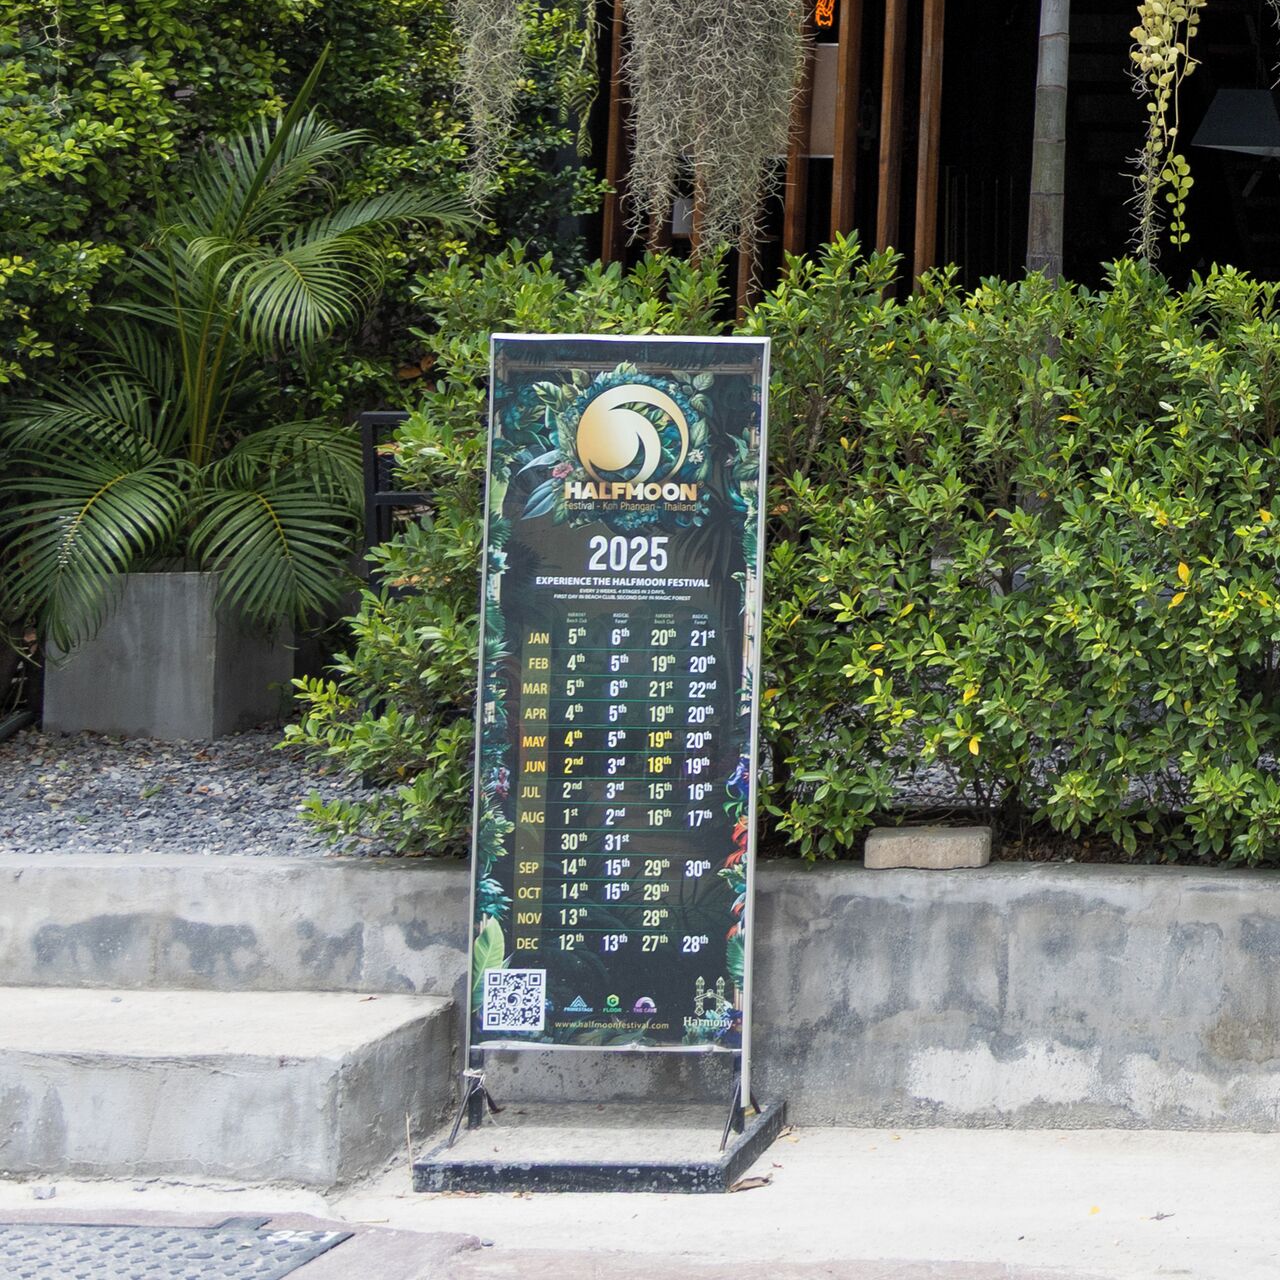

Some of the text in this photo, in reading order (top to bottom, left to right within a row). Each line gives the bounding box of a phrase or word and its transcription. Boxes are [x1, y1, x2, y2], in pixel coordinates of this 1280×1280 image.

[564, 482, 697, 501] HALFMOON
[564, 502, 594, 510] Festival
[620, 503, 655, 512] Phangan
[664, 503, 696, 511] Thailand
[588, 535, 669, 572] 2025
[536, 577, 710, 587] EXPERIENCE THE HALFMOON FESTIVAL
[528, 629, 715, 646] JAN 5th 6th 20th 21st
[529, 654, 715, 672] FEB 4th 5th 19th 20th
[523, 679, 716, 698] MAR 5th 6th 21st 22nd
[524, 704, 713, 723] APR 4th 5th 19th 20th
[523, 731, 712, 748] MAY 4th 5th 19th 20th
[524, 757, 709, 774] JUN 2nd 3rd 18th 19th
[522, 782, 712, 800] JUL 2nd 3rd 15th 16th
[521, 808, 712, 826] AUG 1st 2nd 16th 17th
[561, 833, 629, 850] 30th 31st
[519, 858, 710, 877] SEP 14th 15th 29th 30th
[518, 883, 669, 900] OCT 14th 15th 29th
[517, 909, 668, 926] NOV 13th 28th
[516, 934, 708, 952] DEC 12th 13th 27th 28th
[554, 1021, 669, 1030] www.halfmoonfestival.com
[682, 1016, 733, 1030] Harmony
